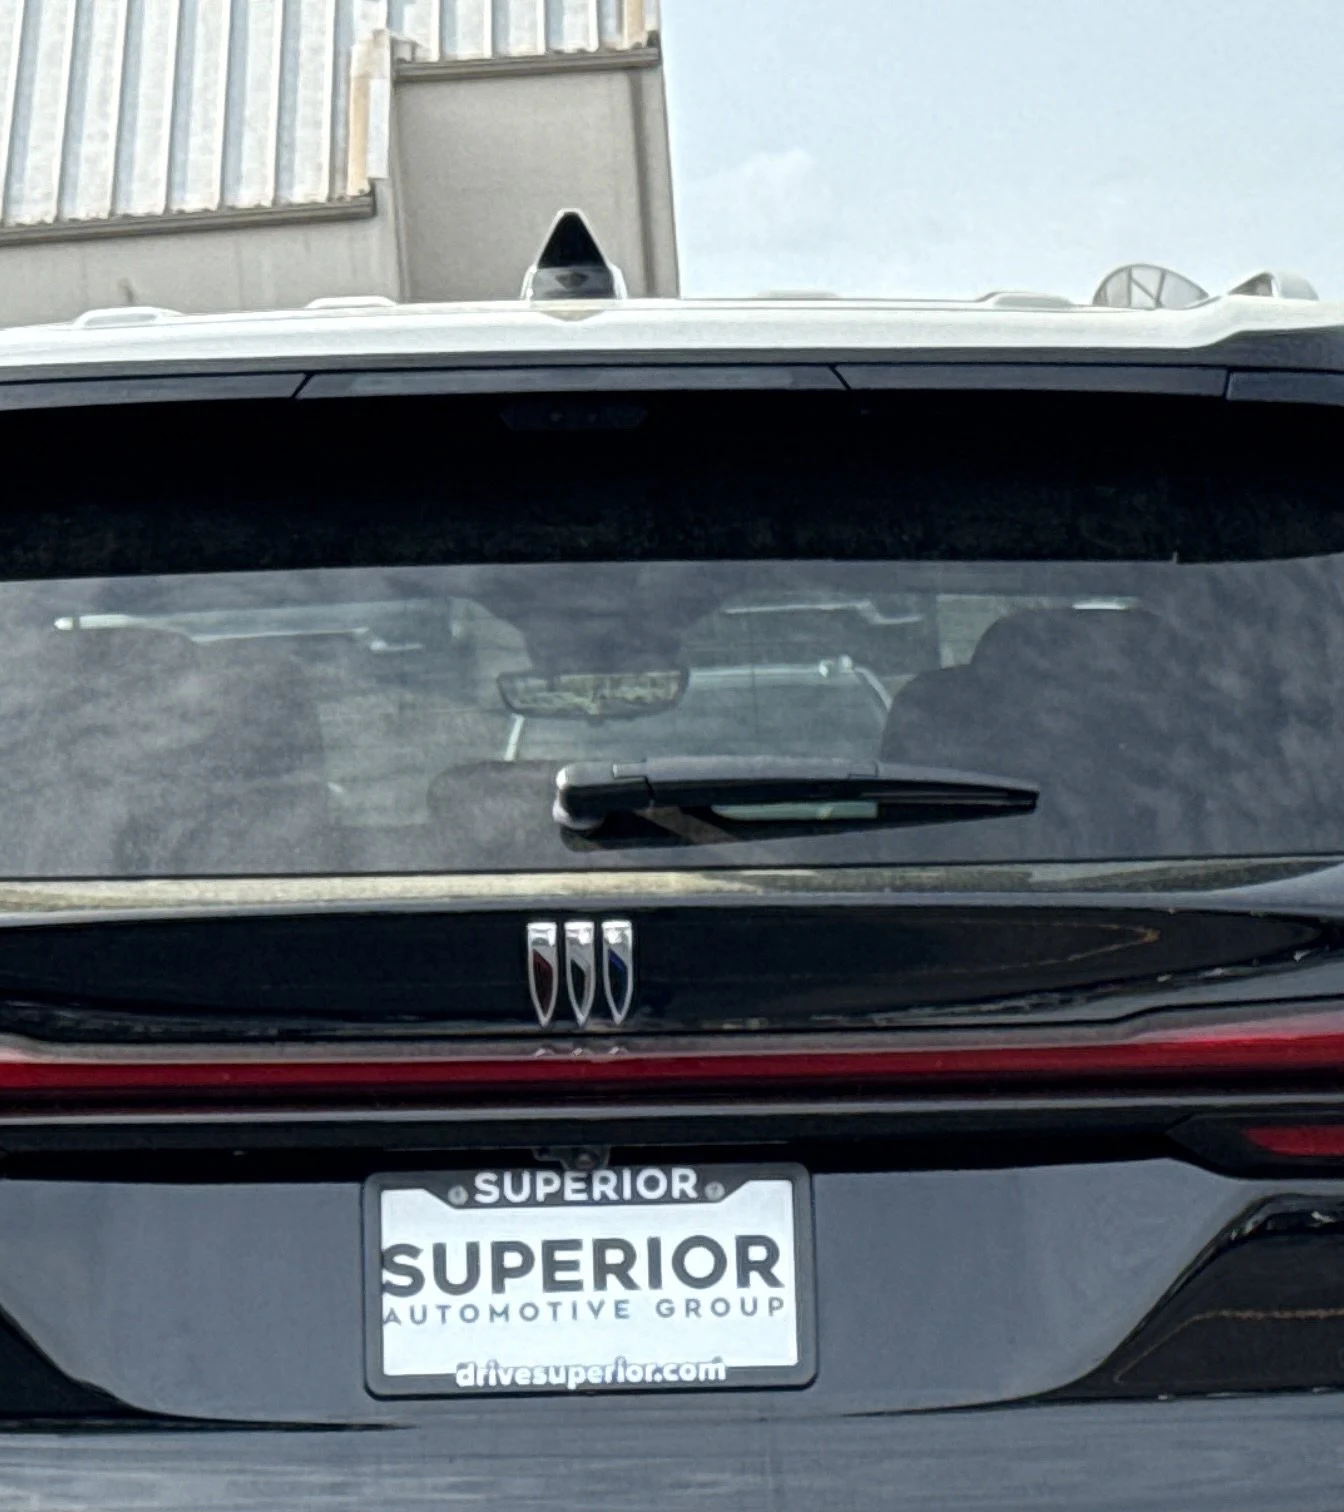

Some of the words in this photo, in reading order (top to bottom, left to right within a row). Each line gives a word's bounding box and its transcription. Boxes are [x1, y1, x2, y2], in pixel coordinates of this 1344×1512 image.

[474, 1167, 698, 1204] SUPERIOR
[381, 1234, 785, 1297] SUPERIOR
[383, 1299, 631, 1326] AUTOMOTIVE
[655, 1297, 785, 1319] GROUP
[455, 1356, 727, 1389] drivesuperior.com
